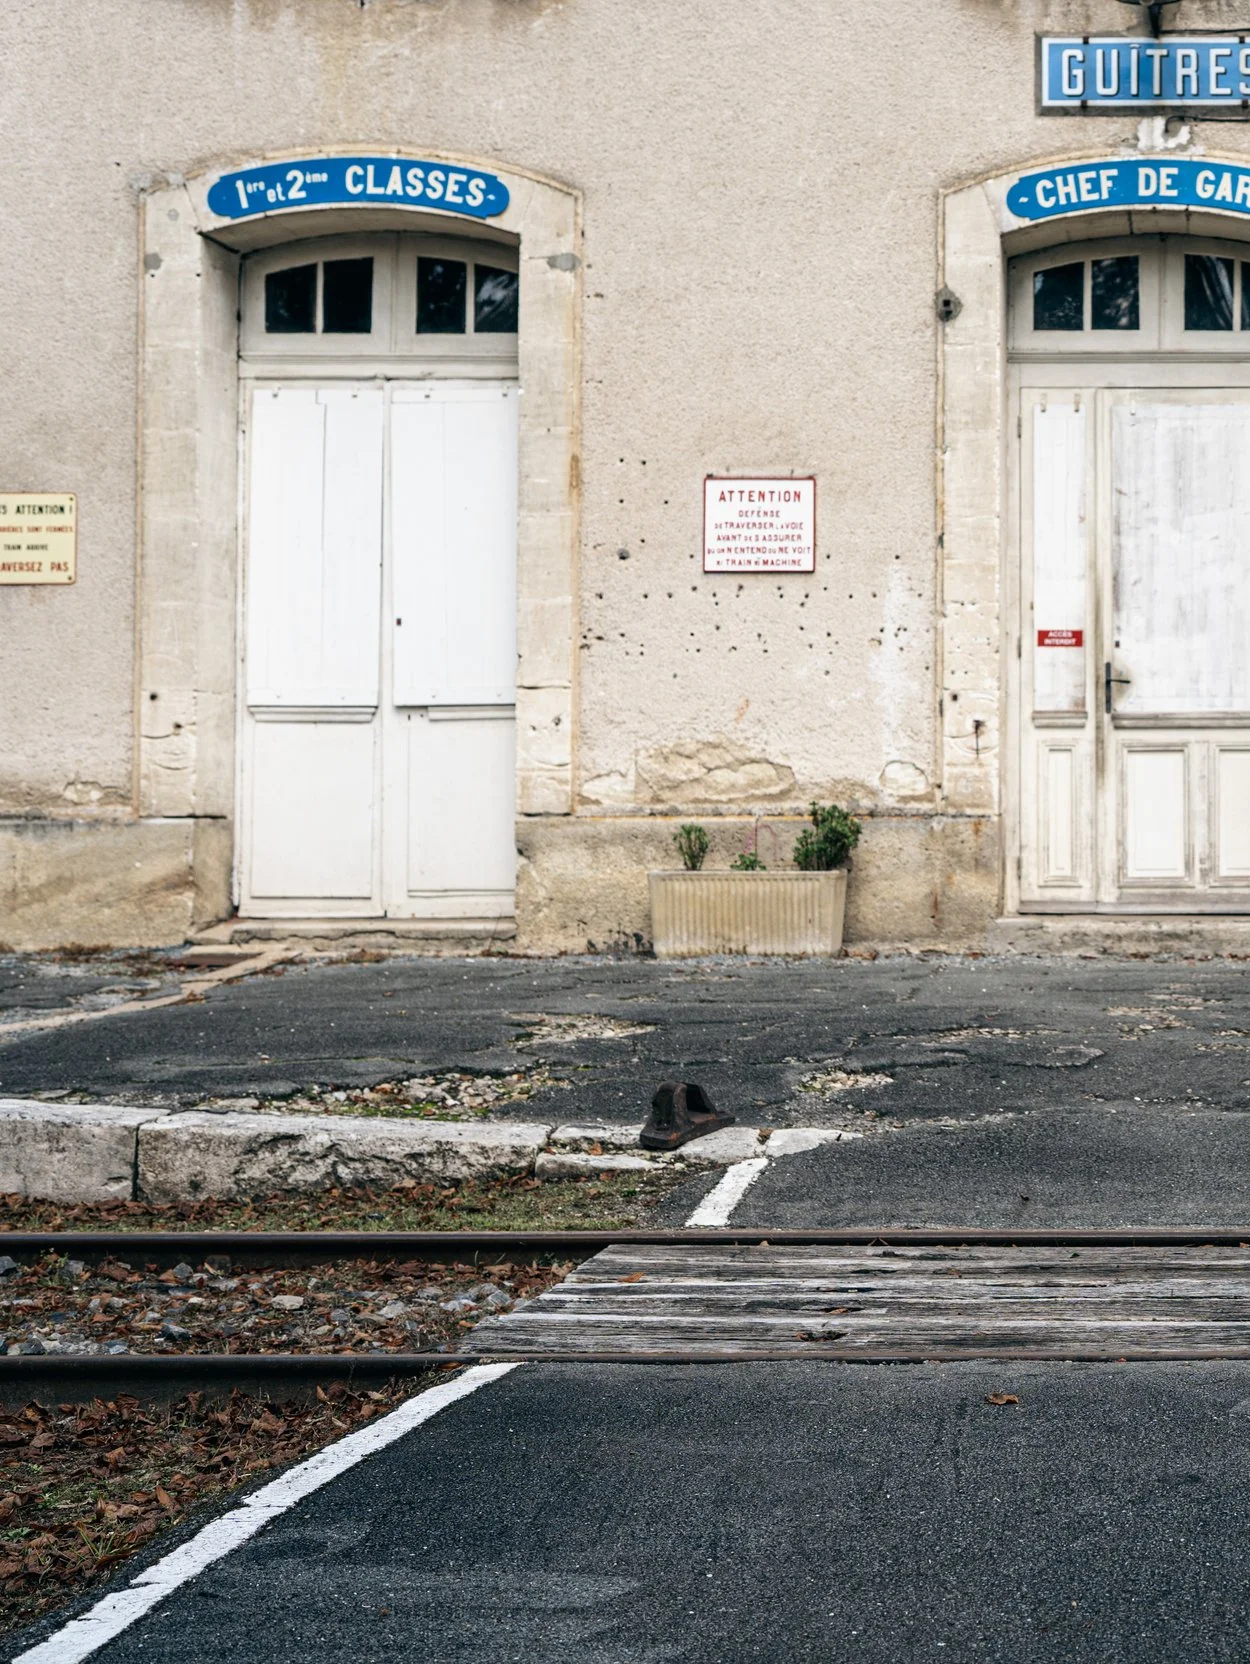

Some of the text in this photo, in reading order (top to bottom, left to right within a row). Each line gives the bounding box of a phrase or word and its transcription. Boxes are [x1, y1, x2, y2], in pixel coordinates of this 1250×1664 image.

[266, 182, 286, 203] et
[344, 164, 487, 207] CLASSES
[1035, 168, 1119, 209] CHEF
[1137, 166, 1179, 197] DE
[718, 490, 801, 502] ATTENTION
[15, 504, 65, 514] ATTENTION
[724, 522, 774, 530] TRAVERSER
[785, 522, 804, 530] VOIE
[717, 534, 741, 542] AVANT
[778, 546, 788, 554] NE
[792, 546, 811, 554] VOIT
[0, 562, 69, 572] AVERSEZ PAS
[726, 559, 752, 567] TRAIN
[762, 559, 802, 567] MACHINE
